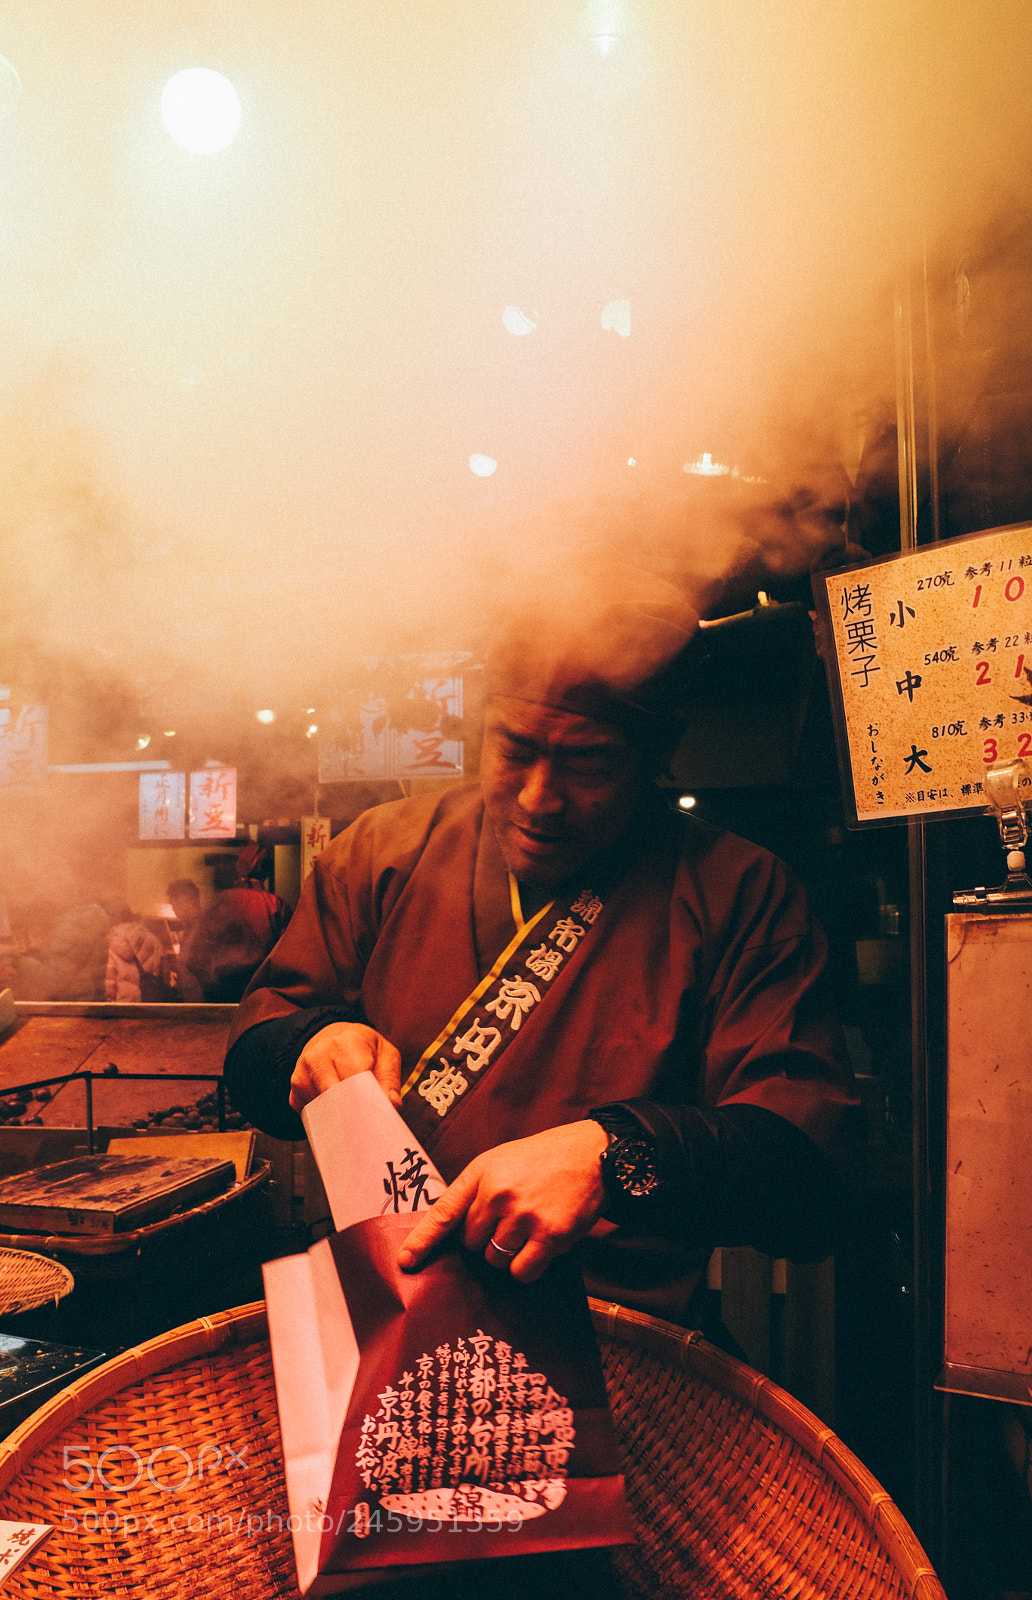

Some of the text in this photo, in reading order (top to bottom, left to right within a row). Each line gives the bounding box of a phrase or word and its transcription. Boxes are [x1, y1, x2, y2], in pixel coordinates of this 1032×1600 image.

[841, 584, 881, 688] 烤栗子
[889, 600, 916, 628] 小
[895, 670, 922, 703] 中
[866, 723, 885, 805] おしながき
[903, 744, 933, 776] 大
[464, 1329, 497, 1485] 京都の台所
